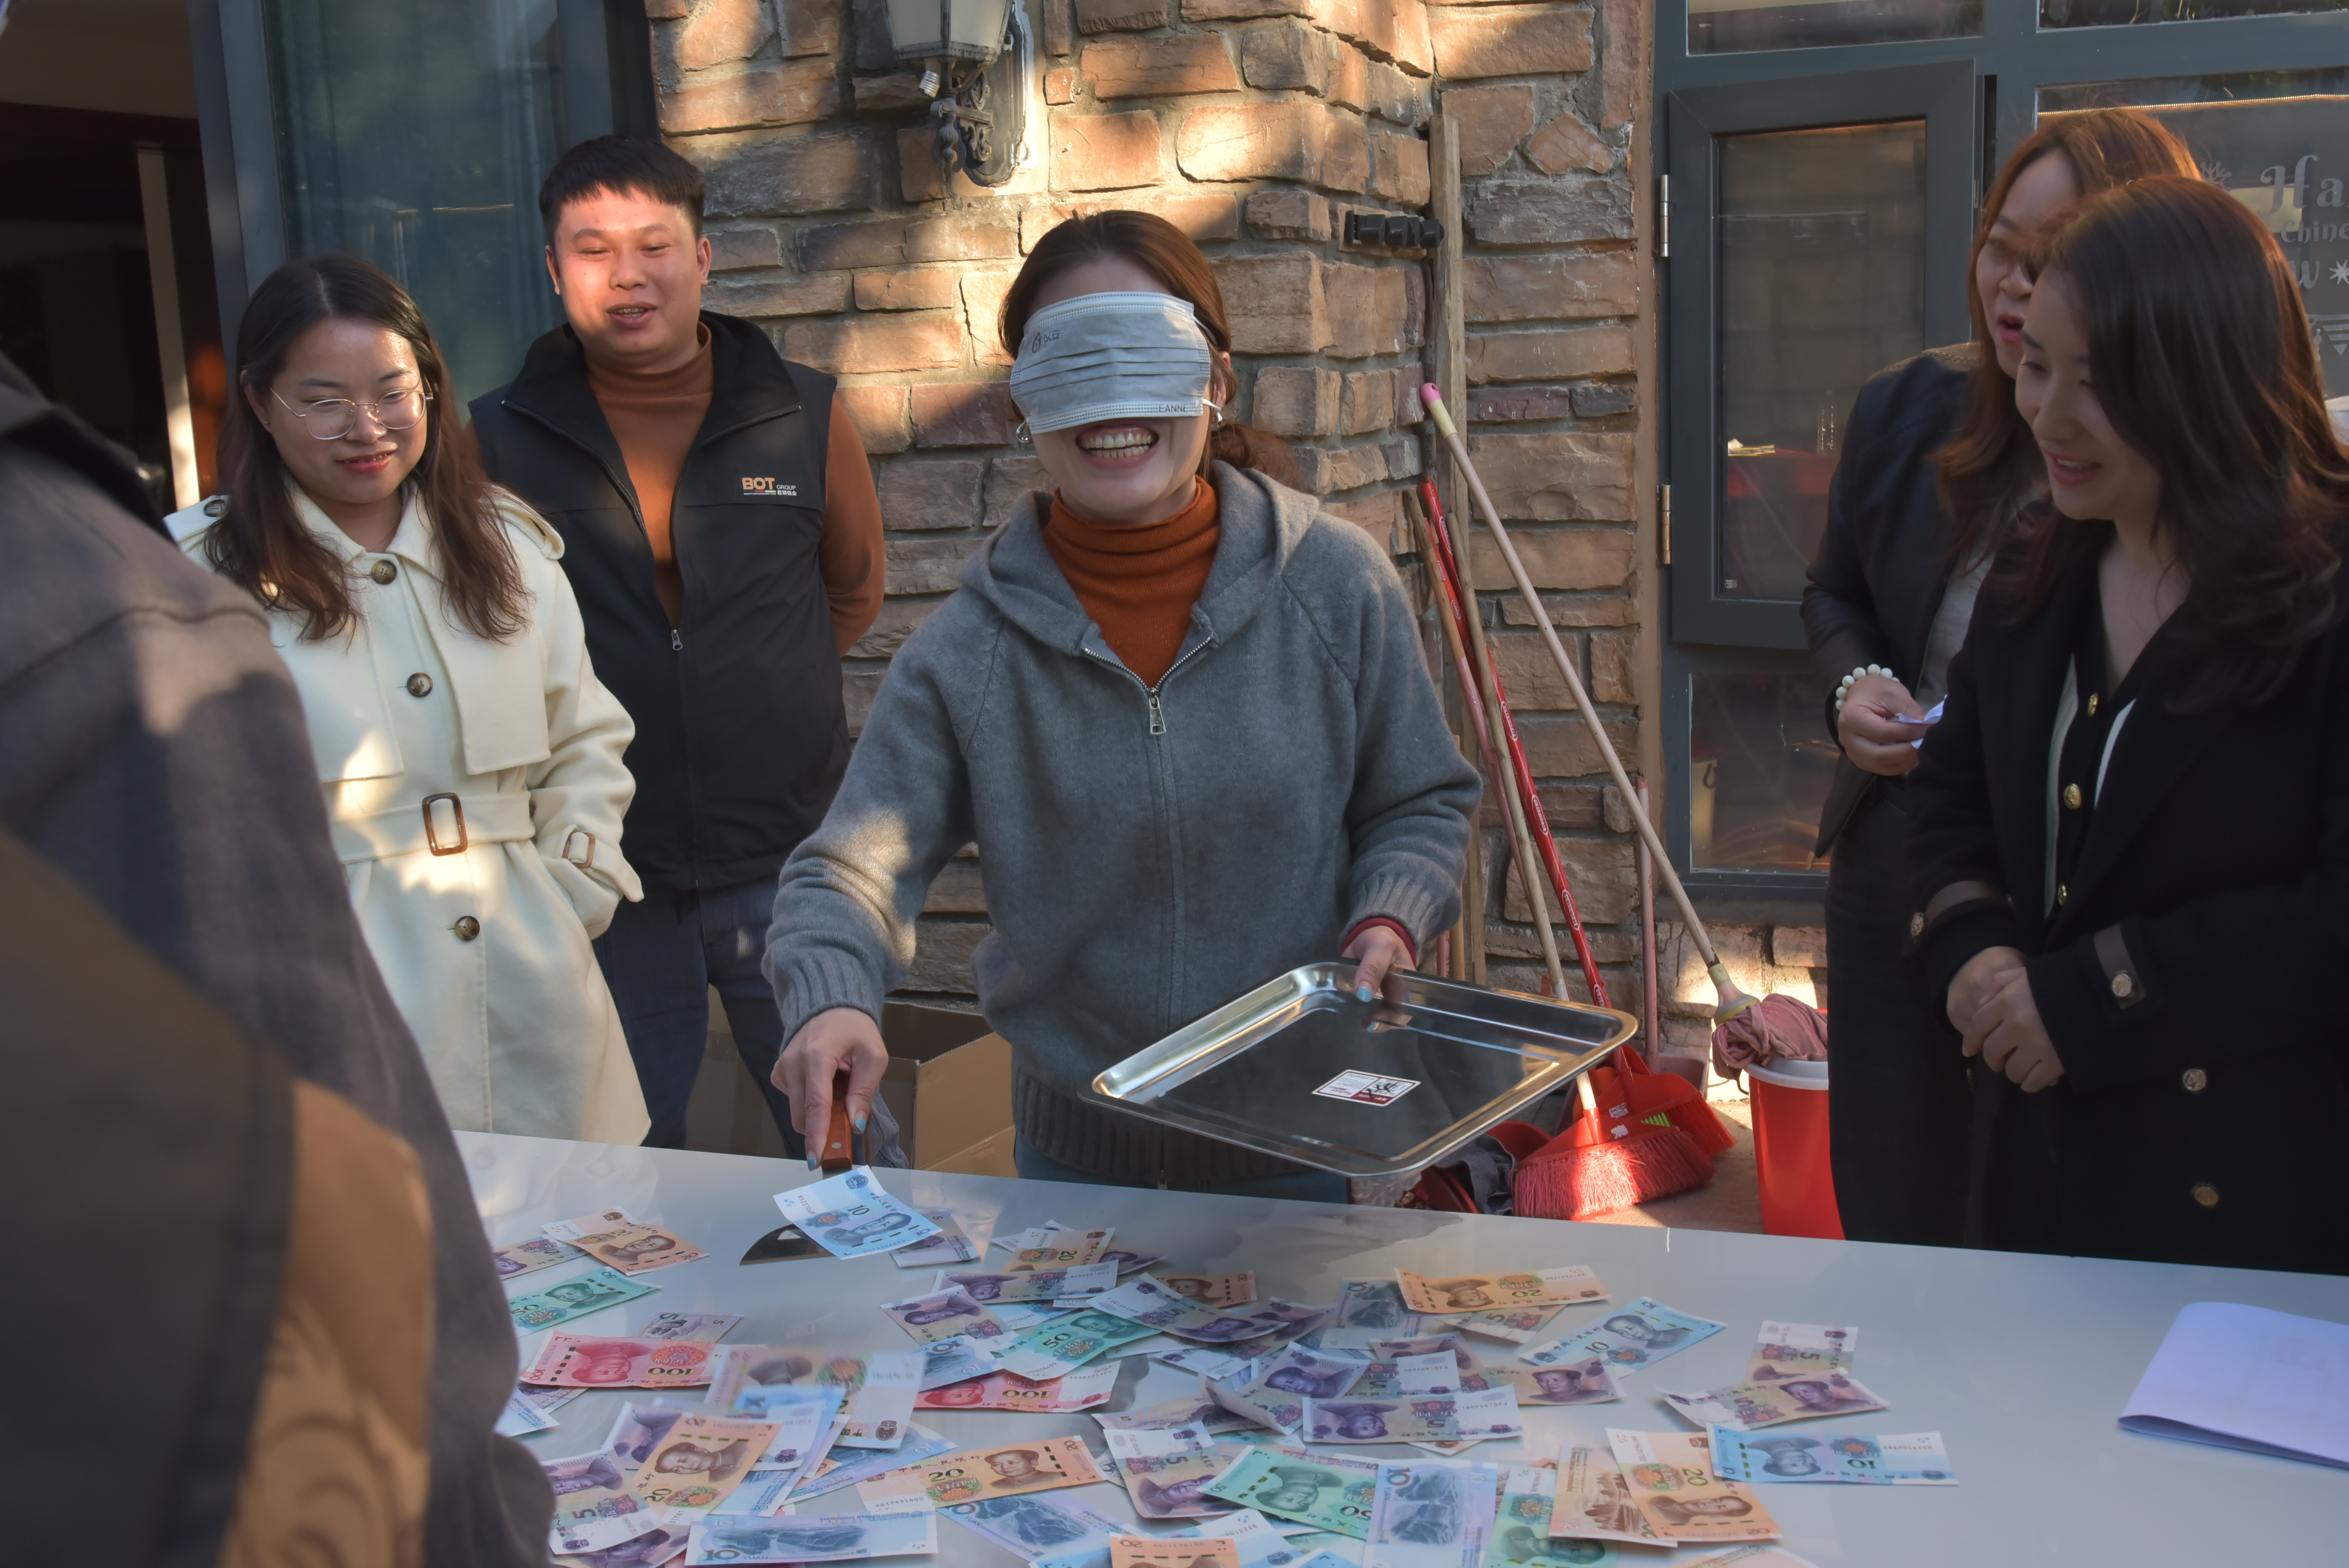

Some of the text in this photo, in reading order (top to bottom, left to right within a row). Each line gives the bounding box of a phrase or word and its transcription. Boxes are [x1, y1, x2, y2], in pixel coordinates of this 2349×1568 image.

[2260, 155, 2349, 216] Ha
[1158, 404, 1188, 413] EANNE
[742, 477, 775, 490] BOT
[1451, 600, 1460, 618] YINGLI
[847, 1205, 870, 1216] 10
[914, 1228, 931, 1236] 10
[681, 1252, 699, 1261] 20
[1058, 1251, 1078, 1261] 20
[601, 1270, 618, 1279] 50
[1237, 1274, 1249, 1282] 20
[1348, 1281, 1368, 1293] 10
[1512, 1289, 1543, 1297] 20
[511, 1304, 540, 1316] 50
[1641, 1301, 1657, 1309] 10
[660, 1312, 679, 1321] 5
[1489, 1312, 1506, 1322] 5
[932, 1340, 963, 1353] 10
[1043, 1333, 1072, 1349] 50
[1585, 1341, 1610, 1353] 10
[1800, 1352, 1821, 1360] 5
[530, 1368, 545, 1381] 100
[647, 1367, 695, 1376] 100
[1369, 1379, 1387, 1388] 5
[1002, 1390, 1050, 1399] 100
[1734, 1397, 1754, 1407] 5
[1427, 1418, 1445, 1429] 5
[1064, 1440, 1079, 1450] 20
[1167, 1455, 1189, 1465] 5
[1846, 1459, 1876, 1470] 10
[928, 1468, 964, 1482] 20
[1387, 1466, 1412, 1486] 10
[1682, 1466, 1708, 1487] 20
[1210, 1481, 1228, 1493] 50
[644, 1488, 672, 1503] 20
[875, 1497, 924, 1508] RB19631800
[572, 1508, 597, 1520] 5
[668, 1510, 684, 1525] 31781
[964, 1514, 982, 1527] YUAN
[1748, 1527, 1771, 1536] 20
[1119, 1539, 1143, 1548] 20
[703, 1548, 740, 1561] 10
